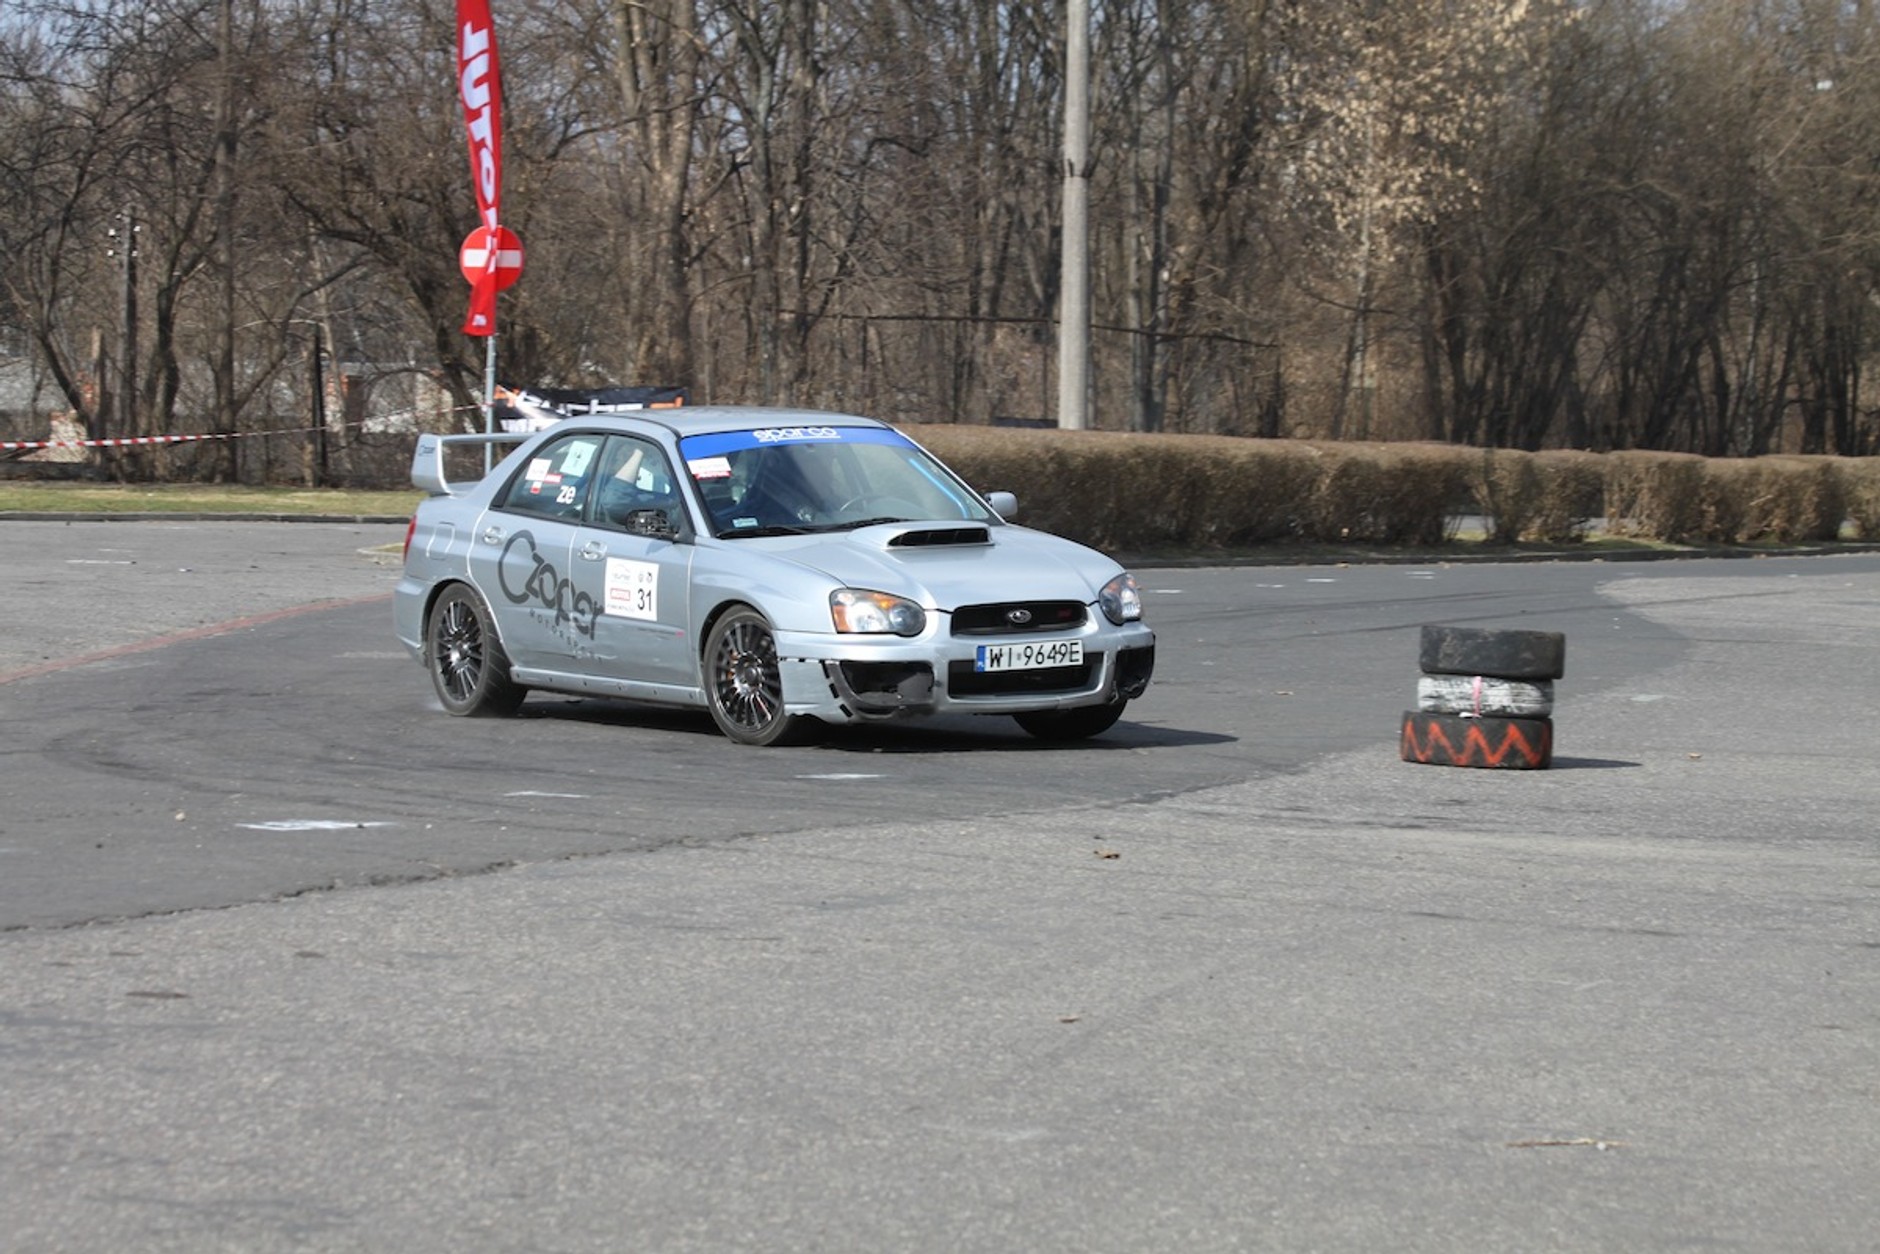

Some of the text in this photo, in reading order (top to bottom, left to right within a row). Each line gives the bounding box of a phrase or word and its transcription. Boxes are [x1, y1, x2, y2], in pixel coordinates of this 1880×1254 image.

[752, 427, 840, 443] sparco
[637, 587, 652, 612] 31
[989, 647, 1012, 668] WI
[1023, 641, 1081, 666] 9649E
